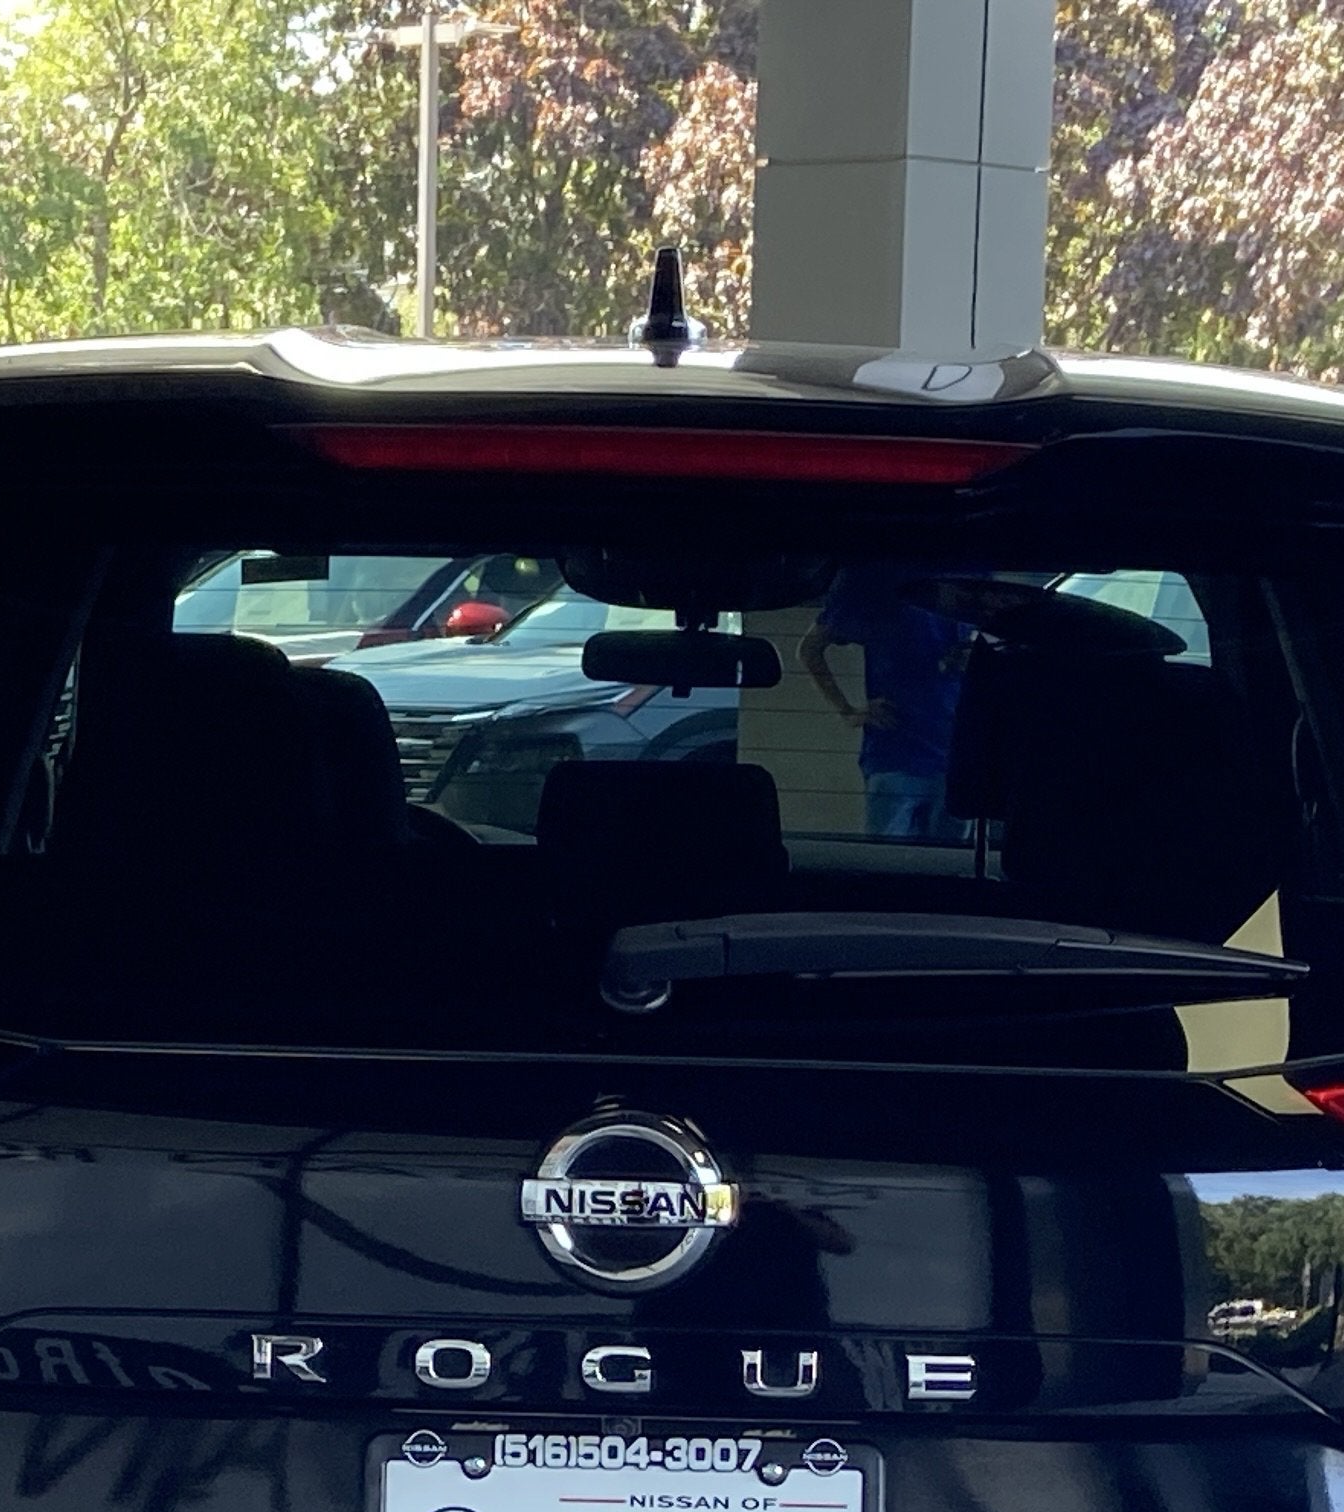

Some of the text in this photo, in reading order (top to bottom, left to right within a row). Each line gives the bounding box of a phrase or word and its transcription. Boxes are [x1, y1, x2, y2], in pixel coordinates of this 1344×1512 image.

[544, 1187, 706, 1222] NISSAN
[251, 1334, 977, 1400] ROGUE
[493, 1433, 762, 1473] (516)504-3007
[630, 1495, 777, 1511] NISSAN OF
